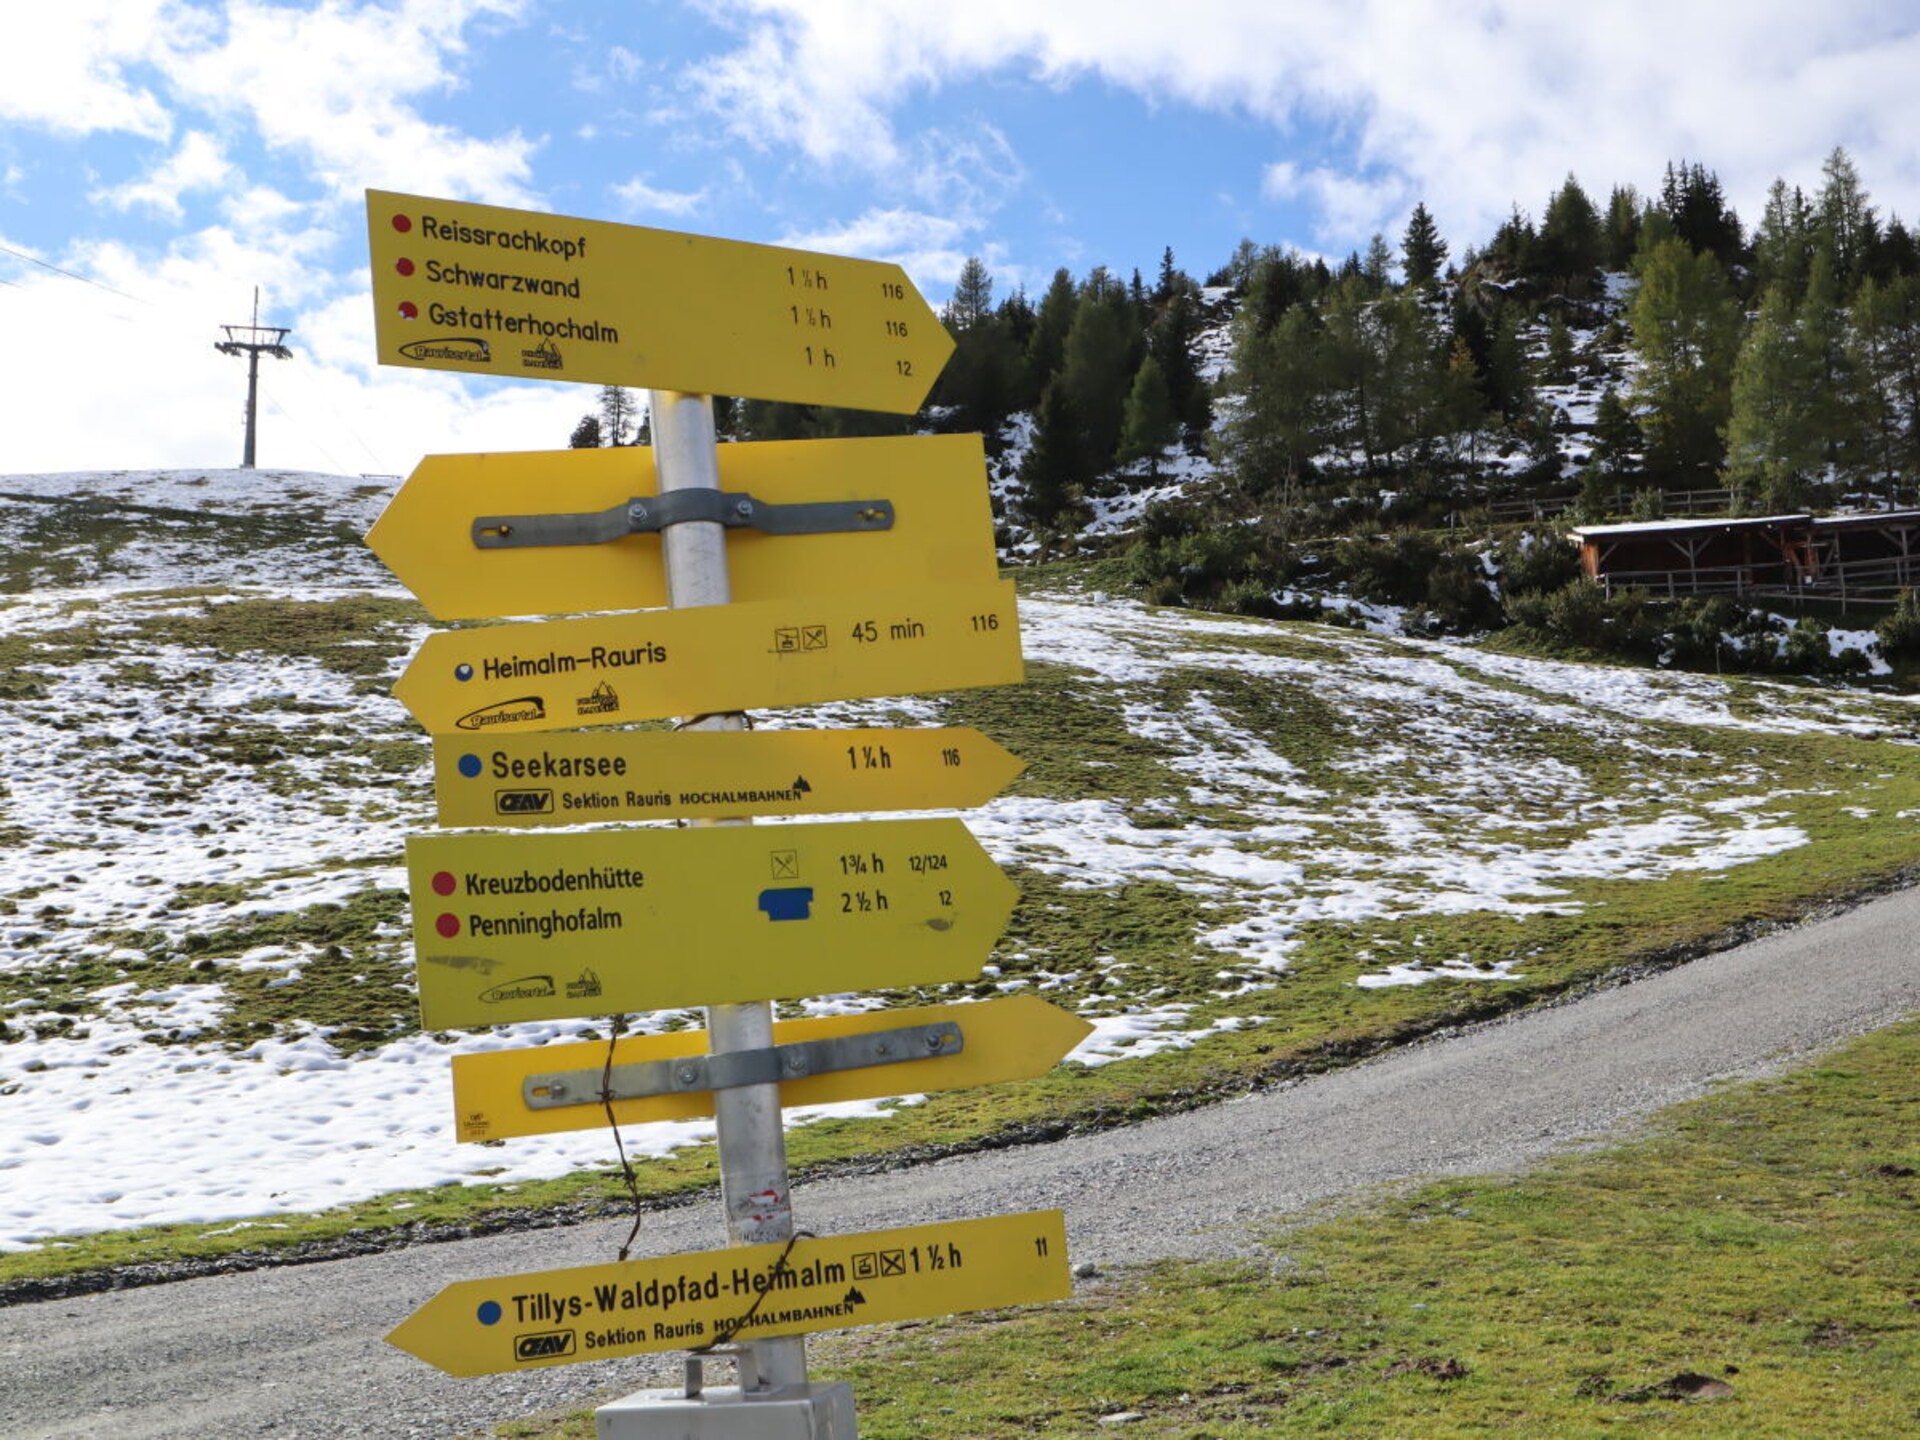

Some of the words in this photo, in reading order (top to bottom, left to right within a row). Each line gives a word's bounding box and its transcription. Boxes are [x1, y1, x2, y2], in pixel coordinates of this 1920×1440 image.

[421, 214, 587, 261] Reissrachkopf
[787, 266, 795, 286] 1
[816, 270, 829, 290] h
[881, 282, 905, 300] 116
[426, 259, 580, 298] Schwarzwand
[791, 305, 799, 325] 1
[820, 309, 832, 329] h
[886, 320, 909, 338] 116
[429, 303, 620, 344] Gstatterhochalm
[805, 346, 814, 366] 1
[823, 348, 836, 368] h
[896, 360, 913, 377] 12
[483, 642, 668, 681] Heimalm-Rauris
[851, 621, 878, 643] 45
[890, 617, 925, 641] min
[971, 614, 999, 632] 116
[492, 751, 627, 779] Seekarsee
[847, 746, 857, 769] 1
[881, 746, 892, 769] h
[942, 748, 961, 767] 116
[562, 791, 620, 810] Sektion
[626, 790, 672, 808] Rauris
[680, 790, 802, 804] HOCHALMBAHNEN
[465, 867, 644, 896] Kreuzbodenhütte
[872, 853, 884, 873] h
[909, 855, 948, 875] 12/124
[470, 907, 622, 939] Penninghofalm
[842, 893, 852, 912] 2
[876, 890, 888, 910] h
[939, 890, 952, 906] 12
[512, 1259, 846, 1324] Tillys-Waldpfad-Heimalm
[910, 1247, 920, 1272] 1
[948, 1242, 962, 1268] h
[1035, 1237, 1048, 1256] 11
[585, 1330, 646, 1350] Sektion
[654, 1319, 704, 1340] Rauris
[714, 1303, 854, 1332] HOCHALMBAHNEN
